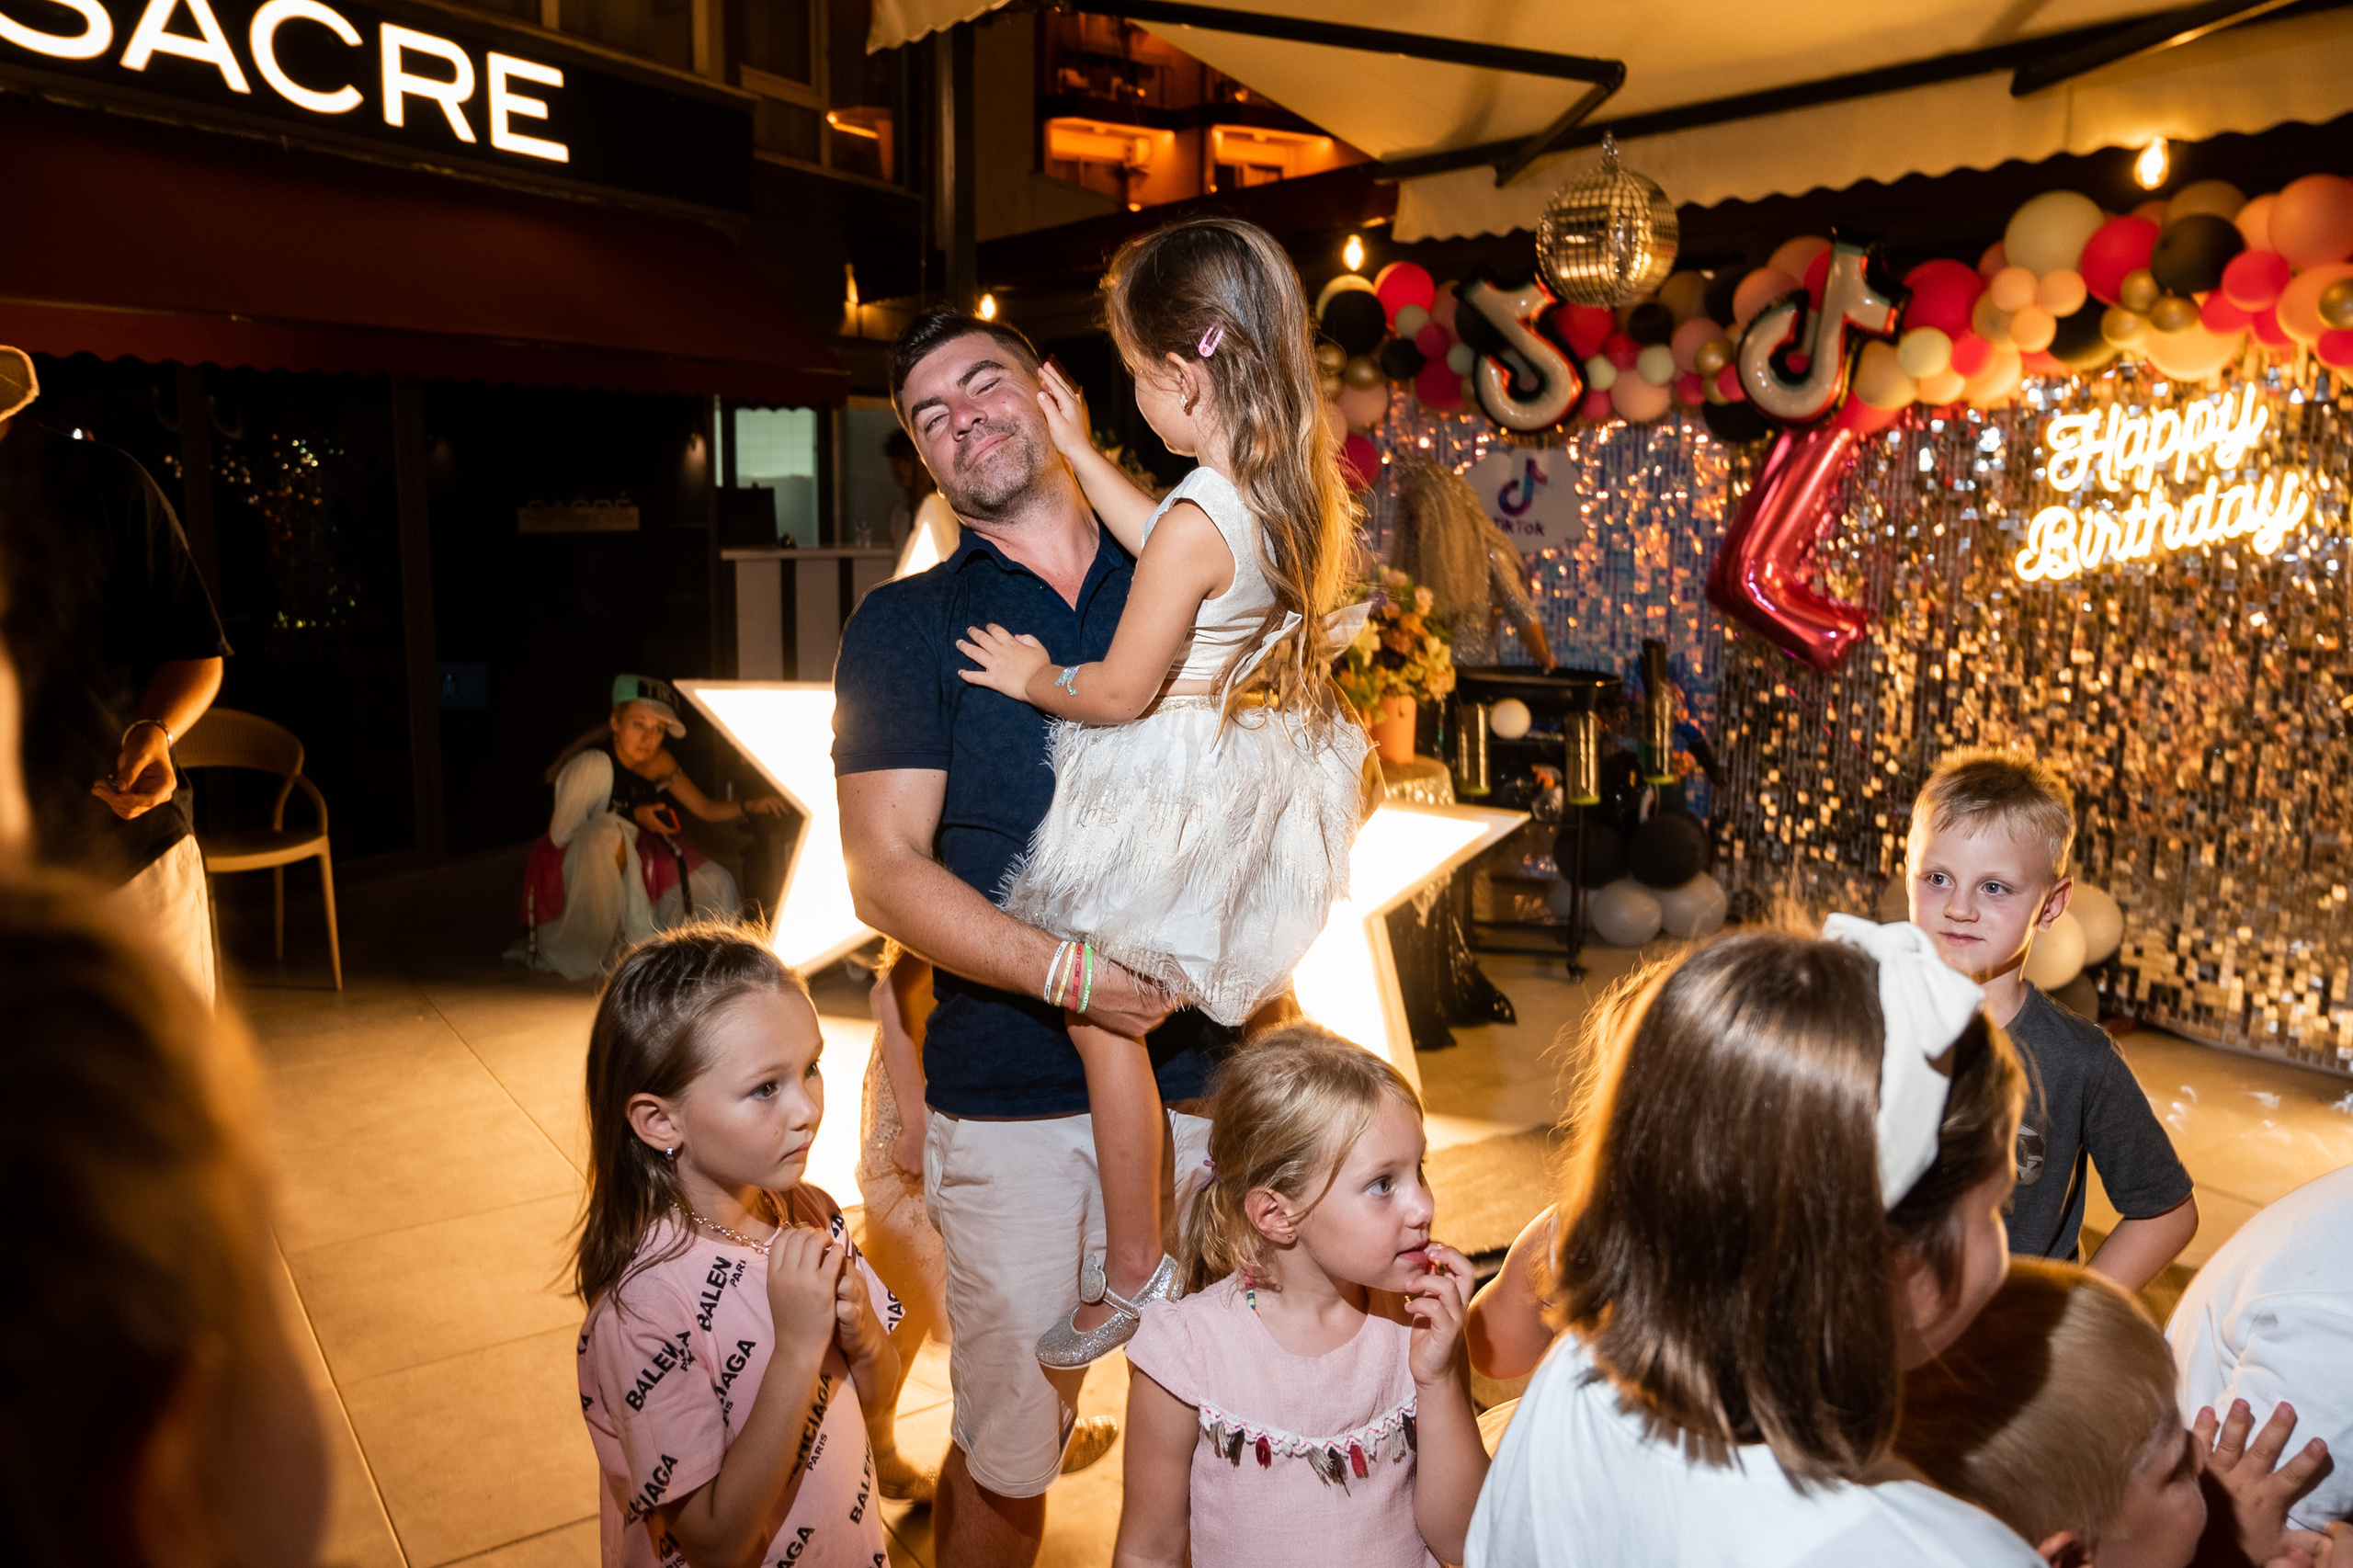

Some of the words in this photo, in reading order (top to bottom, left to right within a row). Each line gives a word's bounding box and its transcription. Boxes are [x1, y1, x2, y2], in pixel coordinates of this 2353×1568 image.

[2047, 381, 2268, 492] Happy
[2014, 471, 2309, 582] Birthday
[696, 1256, 733, 1333] BALEN
[806, 1433, 828, 1471] PARIS
